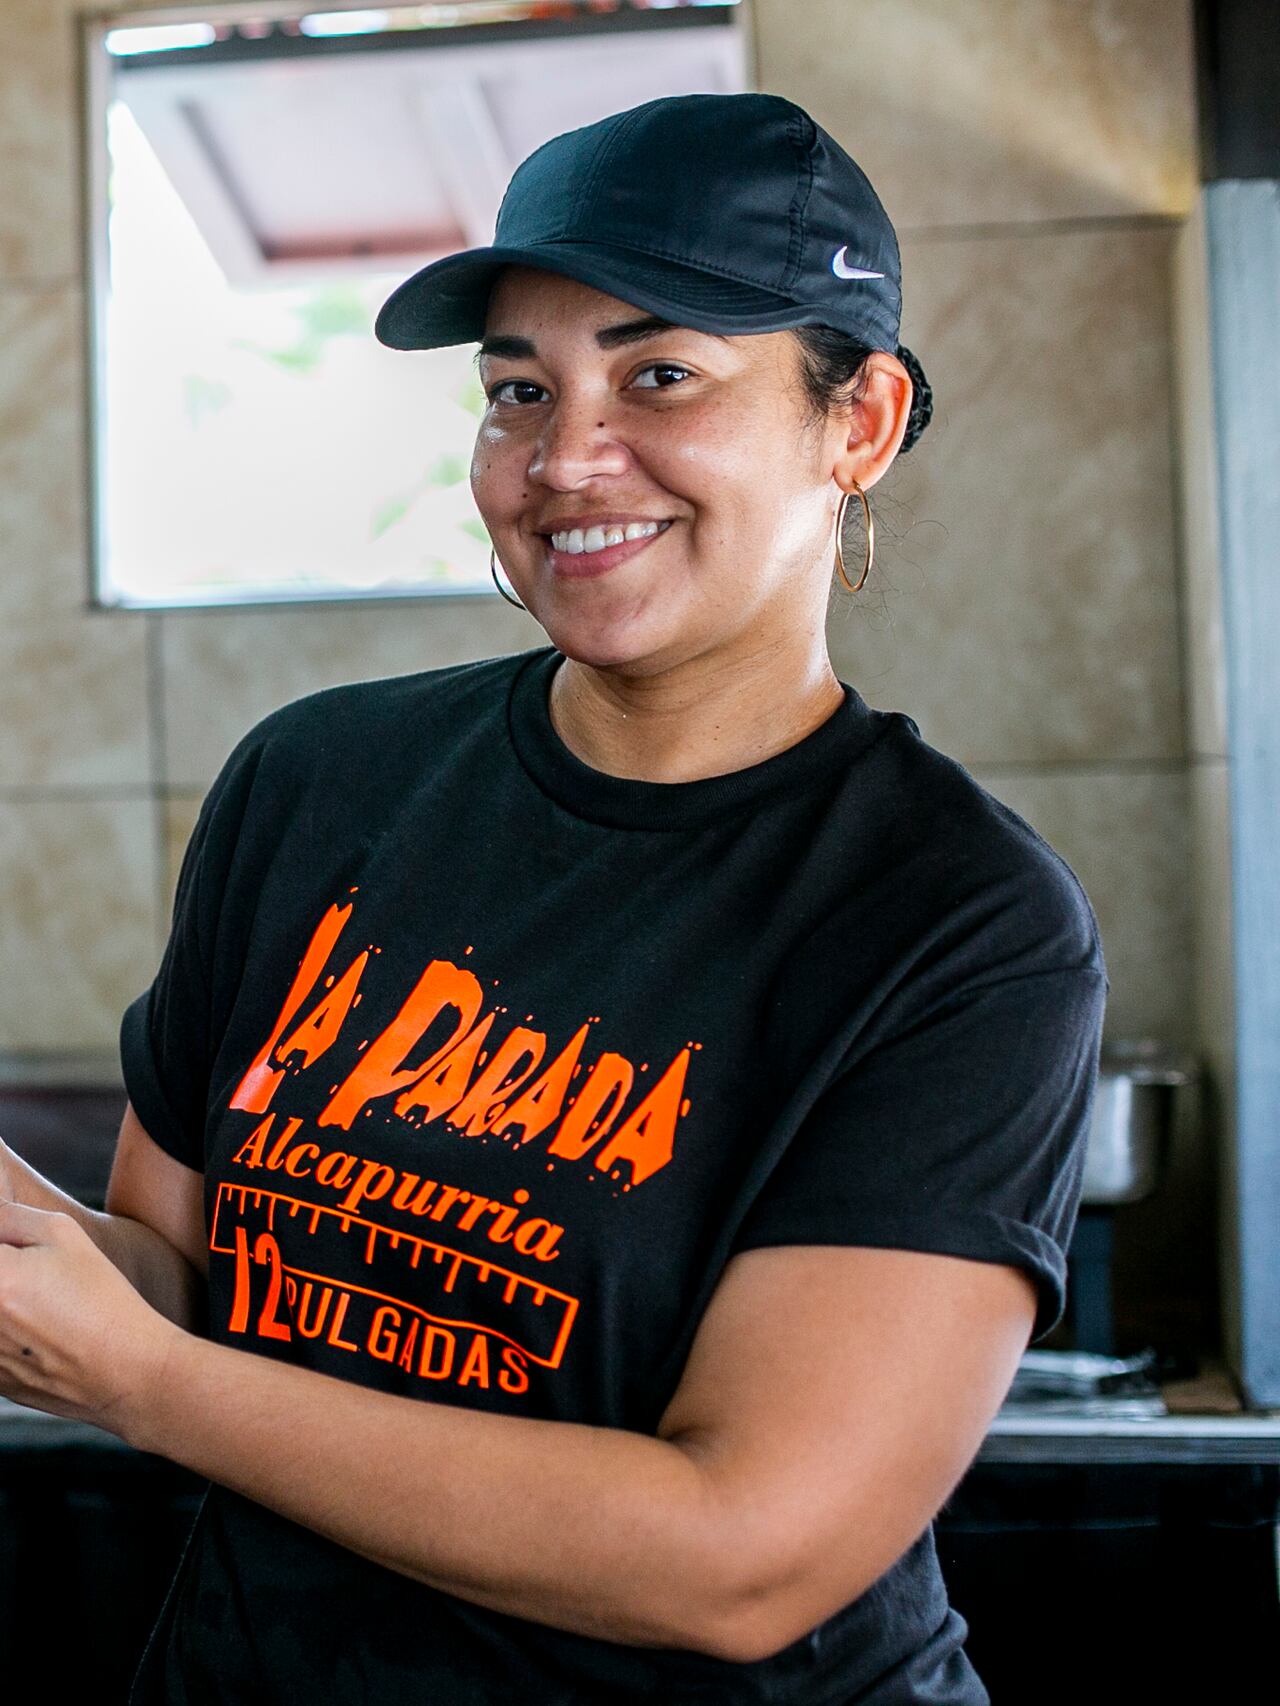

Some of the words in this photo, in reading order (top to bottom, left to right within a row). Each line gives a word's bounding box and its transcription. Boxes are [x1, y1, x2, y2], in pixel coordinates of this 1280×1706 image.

[318, 959, 691, 1186] PARADA
[232, 1112, 565, 1262] Alcapurria
[228, 1226, 292, 1342] 12
[285, 1276, 529, 1394] PULGADAS
